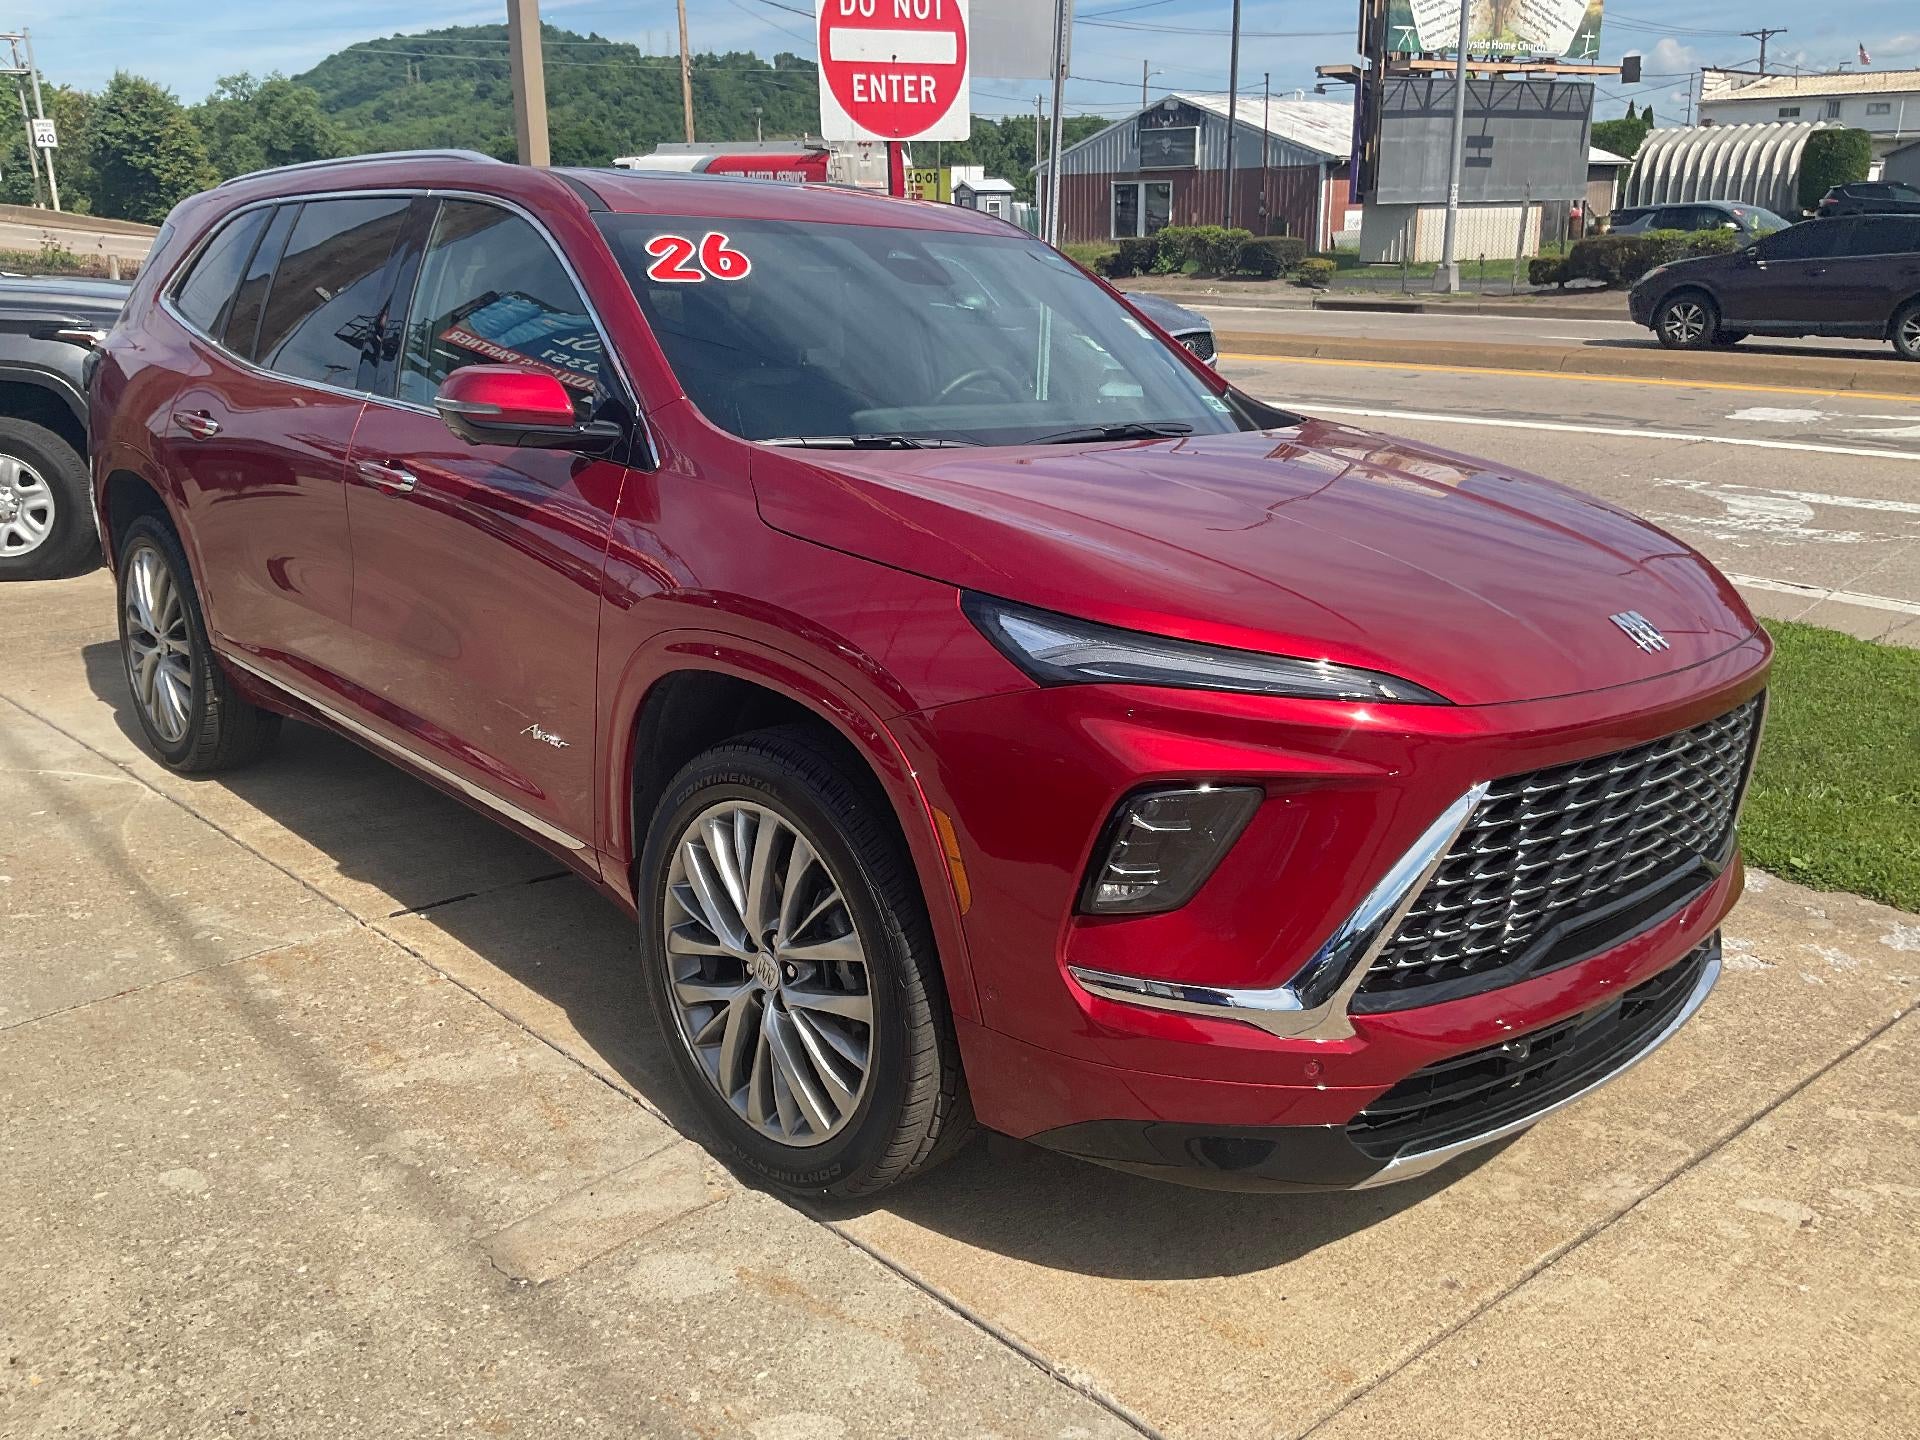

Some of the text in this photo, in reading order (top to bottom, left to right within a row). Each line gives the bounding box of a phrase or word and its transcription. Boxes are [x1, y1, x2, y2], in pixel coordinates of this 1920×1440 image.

[840, 0, 876, 18] DO
[1491, 38, 1514, 51] Home
[1515, 39, 1545, 52] Church
[852, 73, 937, 104] ENTER
[38, 133, 55, 143] 40
[645, 231, 752, 283] 26
